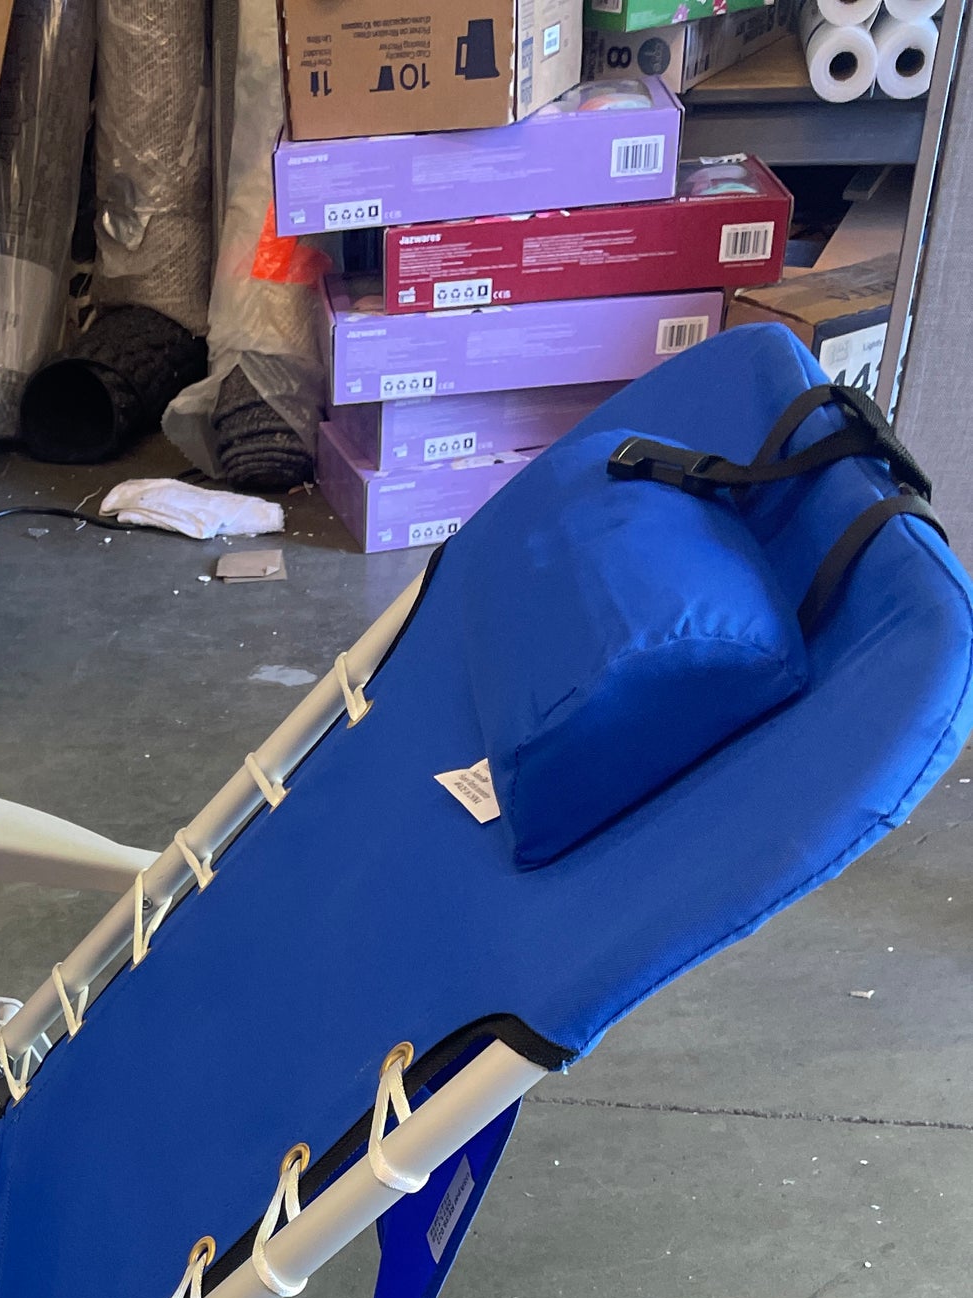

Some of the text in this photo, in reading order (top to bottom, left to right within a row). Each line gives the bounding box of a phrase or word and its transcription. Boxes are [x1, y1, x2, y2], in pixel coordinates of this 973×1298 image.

[608, 46, 632, 69] 8
[323, 71, 332, 96] 1
[399, 63, 431, 91] 10
[398, 234, 442, 245] Jazwares
